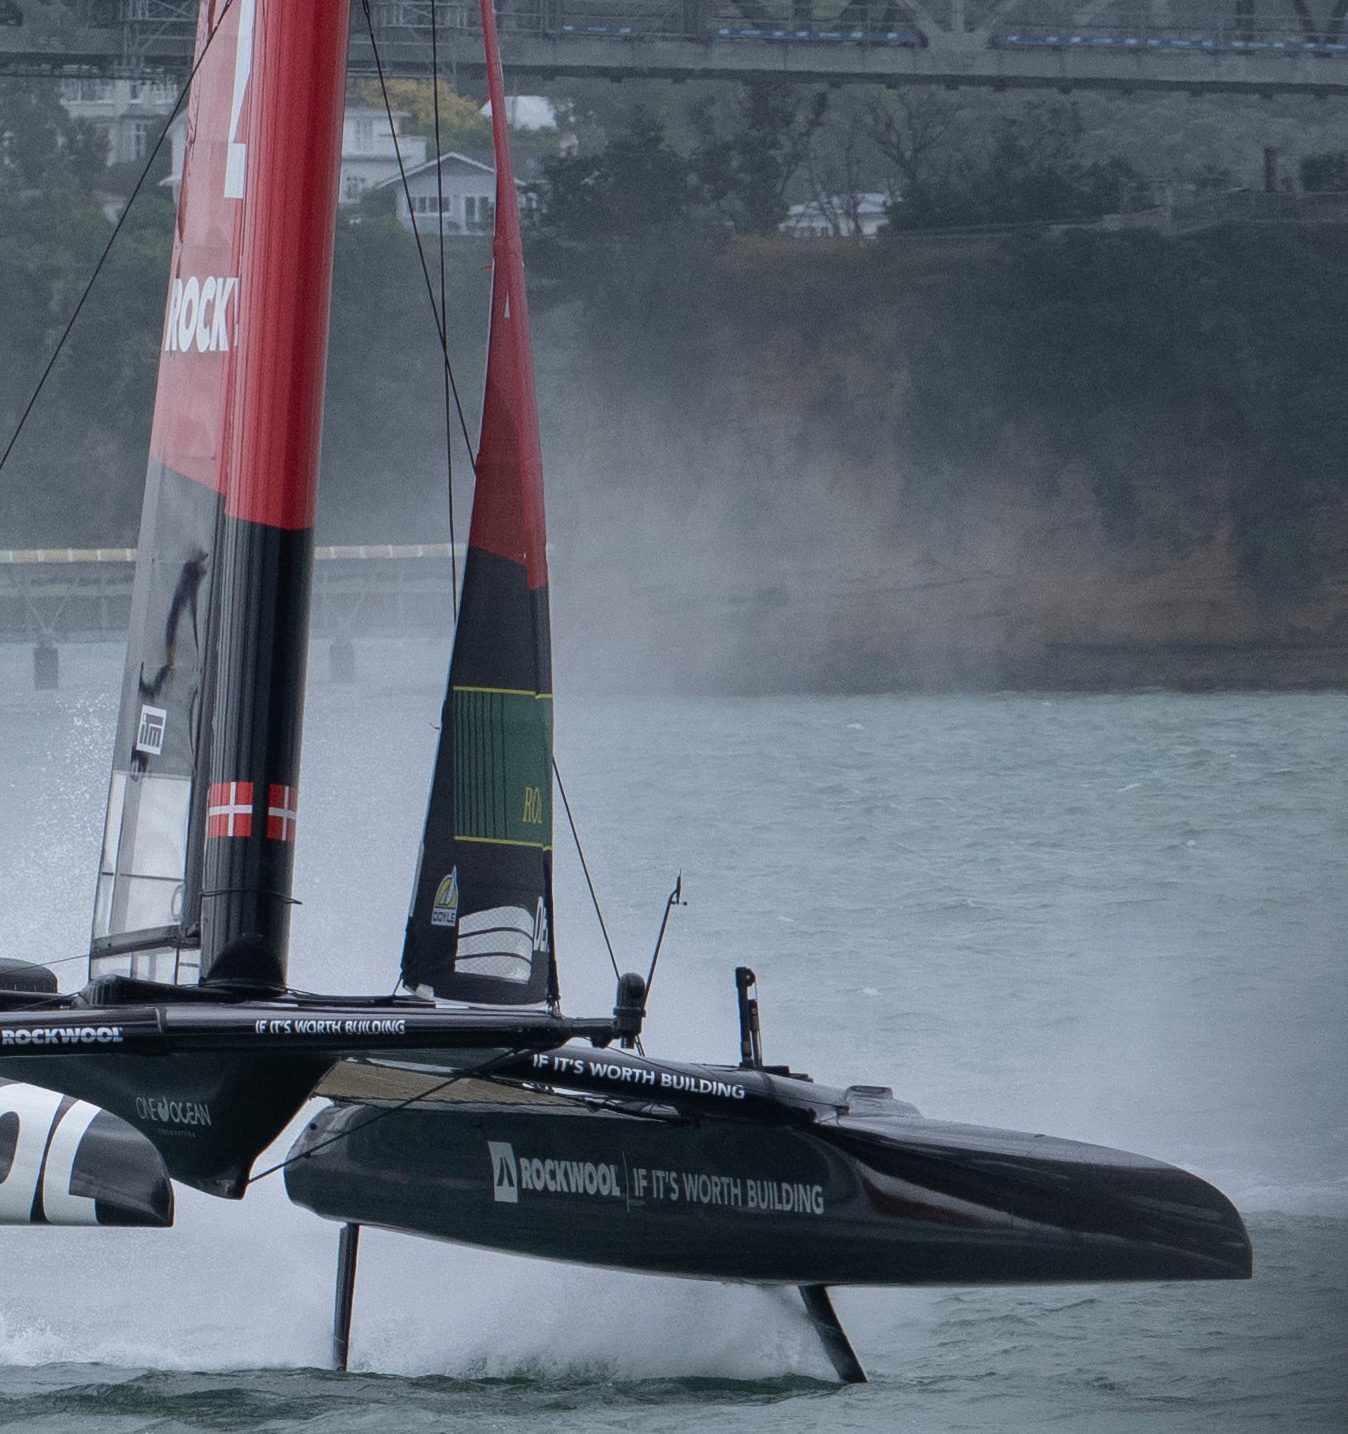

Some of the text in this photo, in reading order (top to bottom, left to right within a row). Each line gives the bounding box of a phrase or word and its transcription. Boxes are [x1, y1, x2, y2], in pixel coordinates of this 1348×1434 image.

[432, 911, 455, 924] DOYLE
[1, 1026, 124, 1045] ROCKWOOL
[255, 1020, 406, 1035] IF IT'S WORTH BUILDING
[533, 1053, 746, 1099] IF IT'S WORTH BUILDING
[135, 1097, 212, 1126] ONE OCEAN
[519, 1157, 825, 1215] ROCKWOOL IF IT'S WORTH BUILDING
